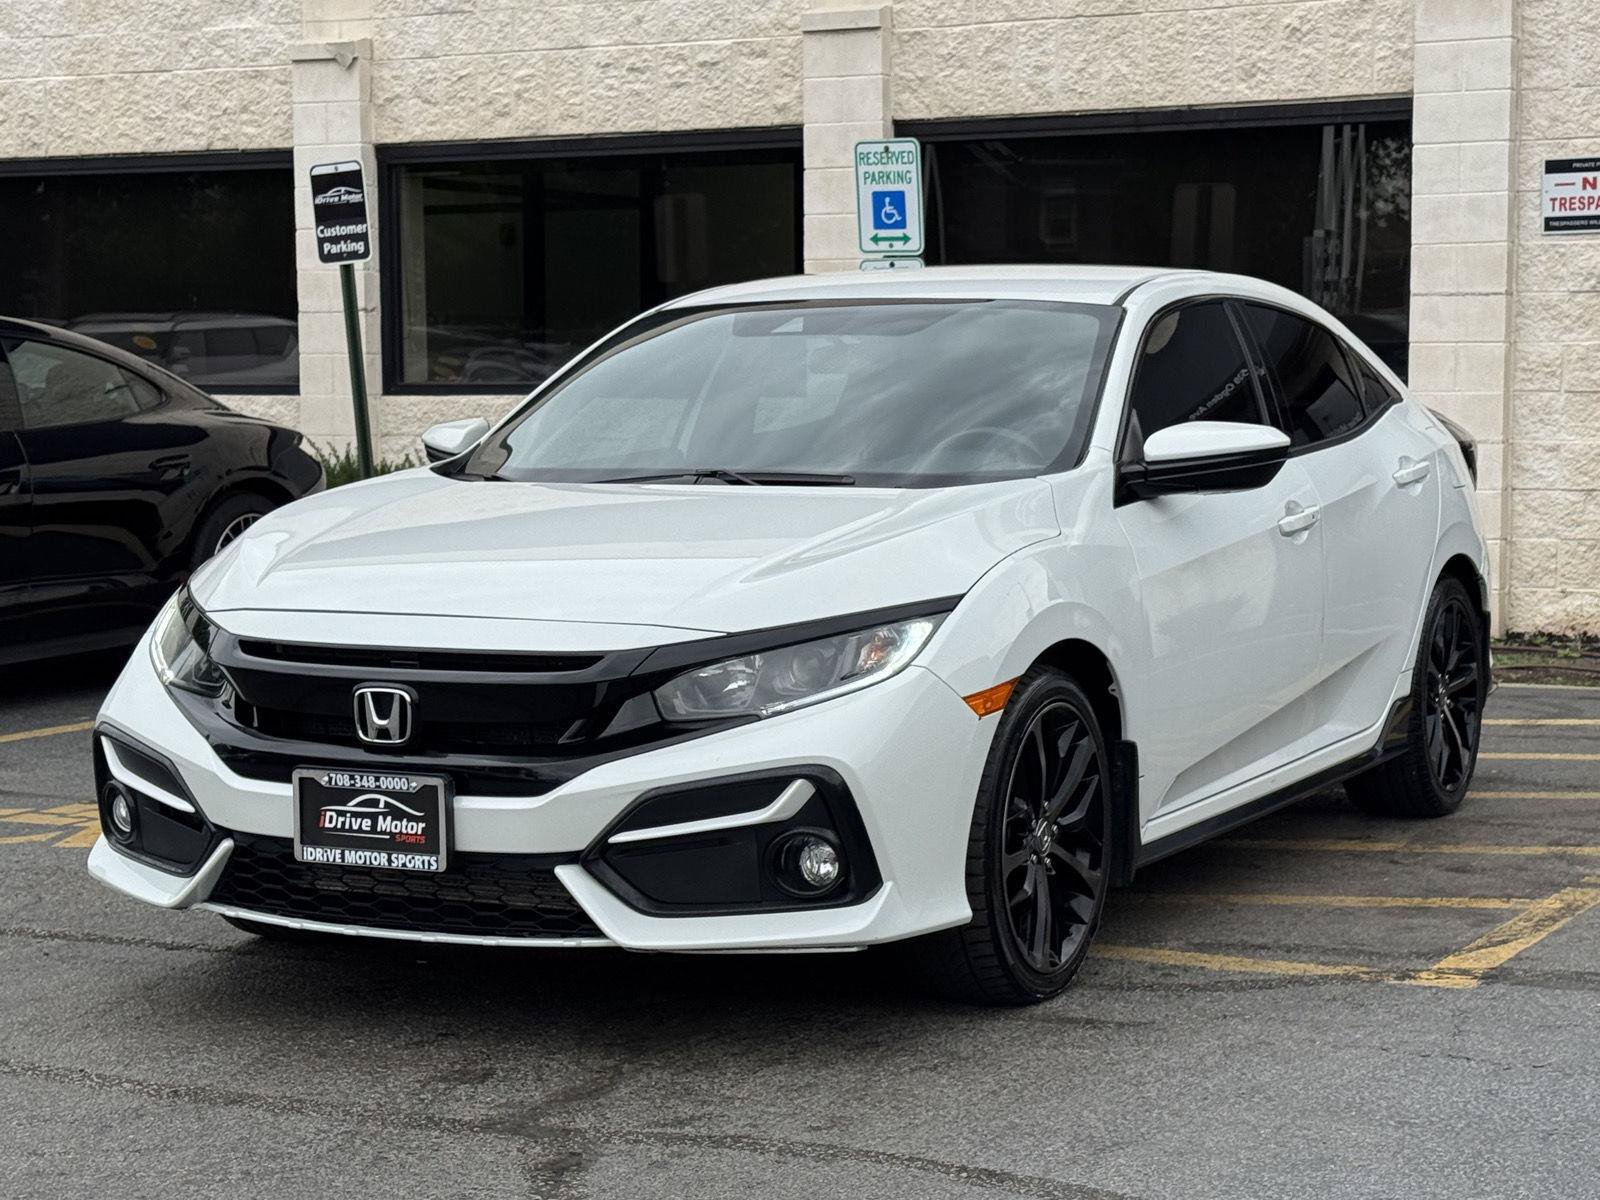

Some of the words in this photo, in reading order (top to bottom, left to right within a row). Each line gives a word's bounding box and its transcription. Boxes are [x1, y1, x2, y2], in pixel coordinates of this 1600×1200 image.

[859, 151, 915, 166] RESERVED
[863, 170, 912, 185] PARKING
[317, 223, 368, 238] Customer
[323, 240, 365, 255] Parking
[329, 773, 408, 790] 708-348-0000
[319, 811, 371, 831] iDrive
[377, 815, 426, 835] Motor
[395, 834, 426, 844] SPORTS
[345, 850, 388, 867] MOTOR
[391, 853, 438, 870] SPORTS
